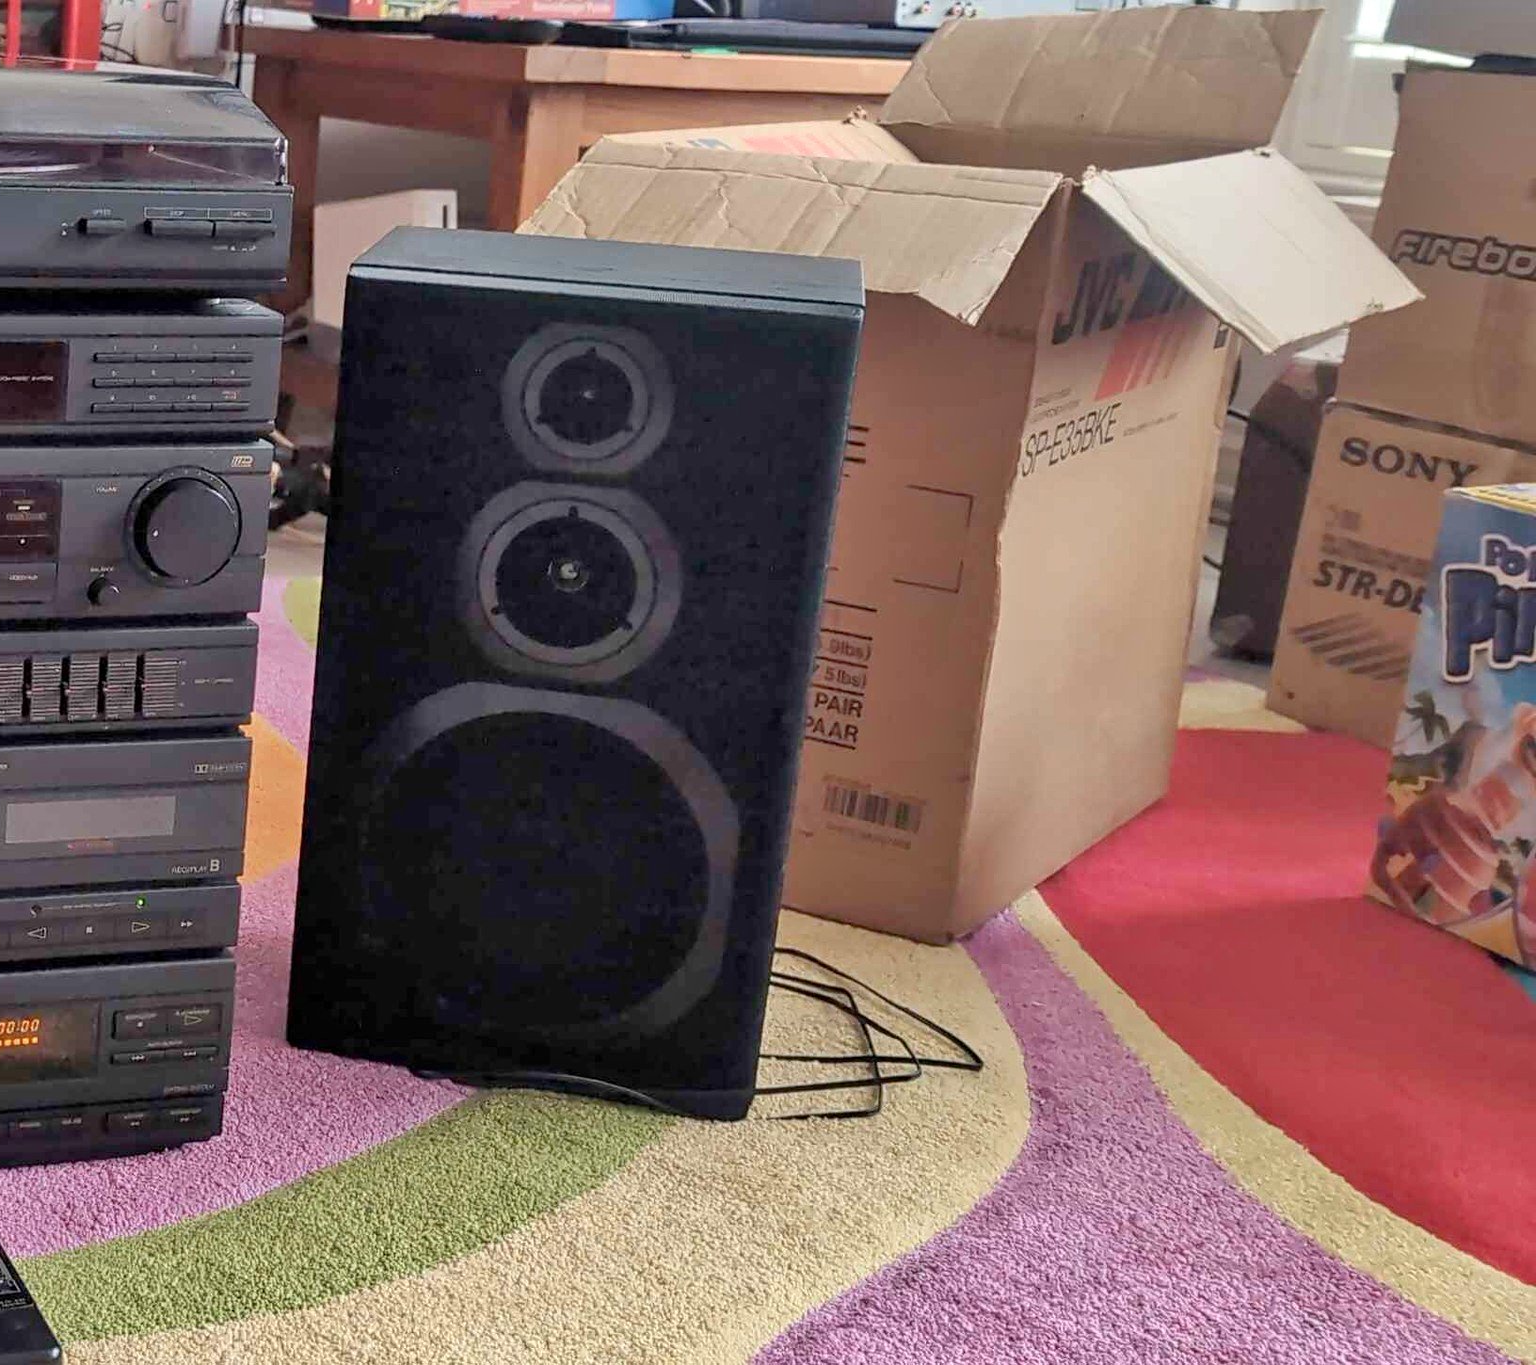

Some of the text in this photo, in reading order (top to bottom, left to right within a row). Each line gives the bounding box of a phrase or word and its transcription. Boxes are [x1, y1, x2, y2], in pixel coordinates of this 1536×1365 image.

[1021, 401, 1122, 478] SP-E35BKE
[1340, 437, 1479, 487] SONY
[814, 692, 864, 718] PAIR
[210, 859, 220, 872] B
